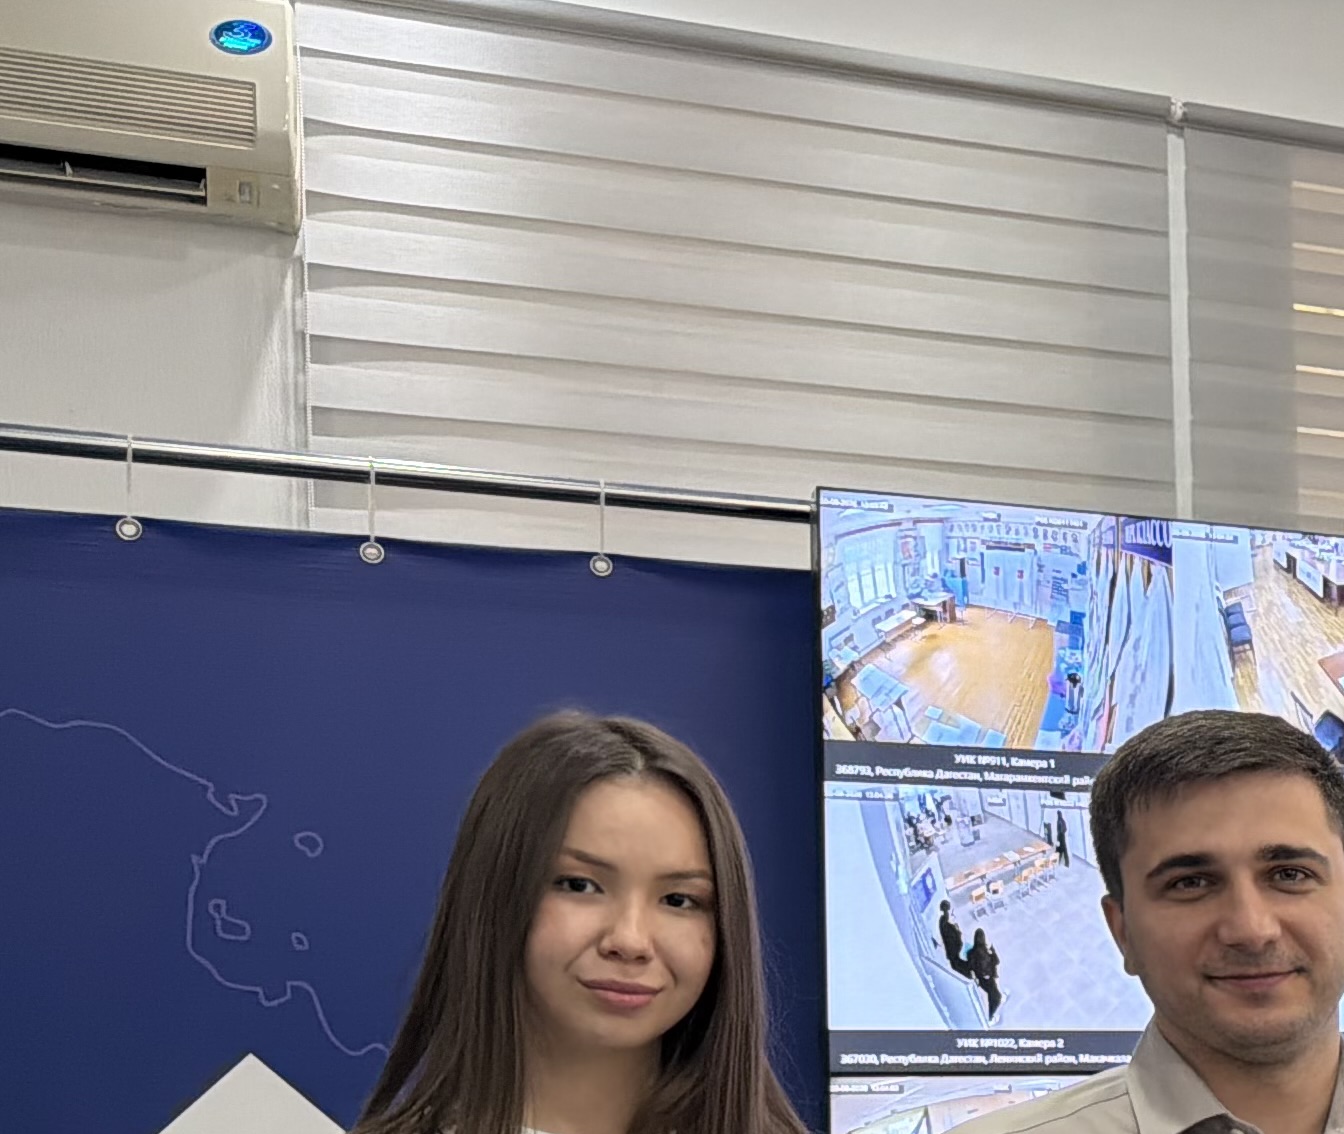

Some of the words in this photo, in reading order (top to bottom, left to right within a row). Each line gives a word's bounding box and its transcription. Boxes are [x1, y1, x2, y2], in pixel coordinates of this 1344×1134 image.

[1011, 757, 1047, 769] Камера
[876, 766, 934, 777] Республика
[935, 769, 982, 780] Дагестан,
[1019, 1038, 1056, 1050] Камера
[881, 1054, 939, 1066] Республика
